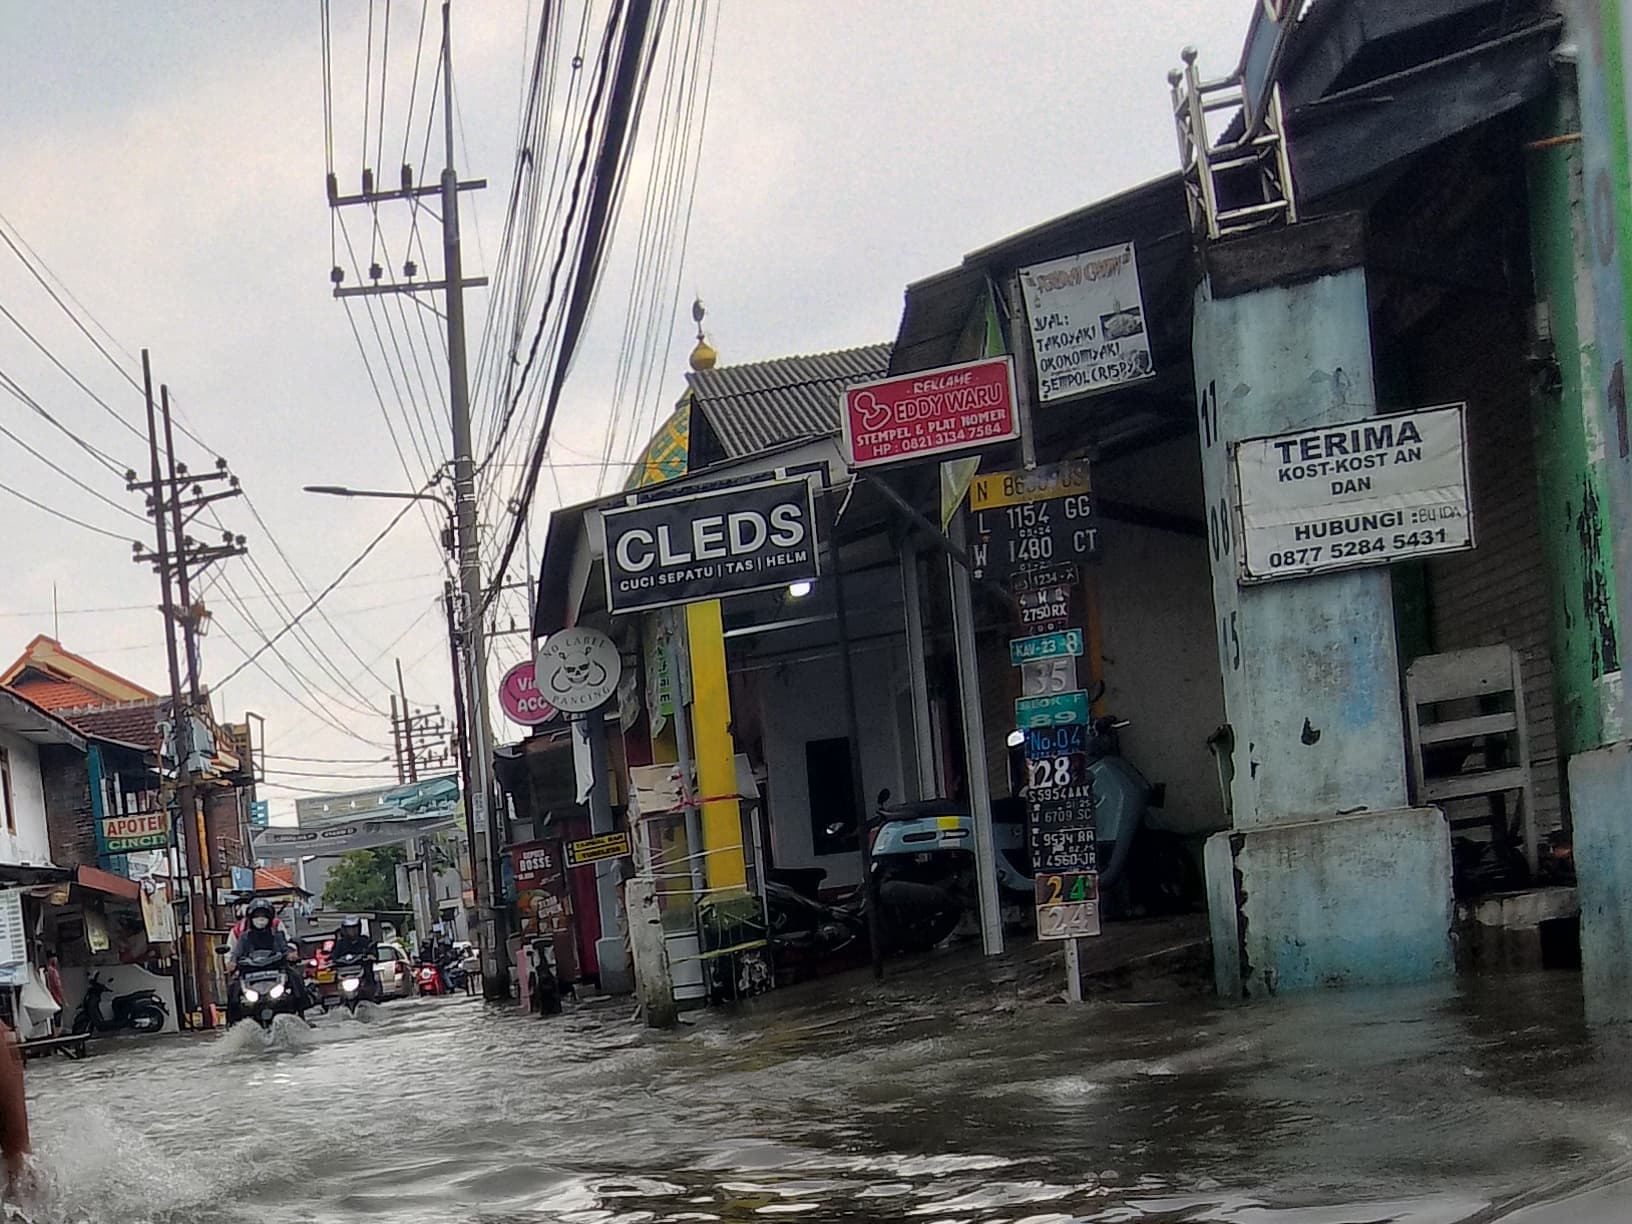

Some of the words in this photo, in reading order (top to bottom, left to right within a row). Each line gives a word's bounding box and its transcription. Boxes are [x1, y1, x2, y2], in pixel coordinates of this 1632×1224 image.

[1036, 325, 1096, 352] TAKOYAKI
[913, 372, 973, 394] REKLAME
[894, 394, 944, 423] EDDY
[944, 383, 1002, 413] WARU
[856, 427, 911, 447] STEMPEL
[928, 417, 956, 433] PLAT
[961, 409, 1006, 427] NOMER
[872, 444, 892, 457] HP
[902, 435, 932, 451] 0821
[935, 430, 965, 446] 3134
[969, 422, 1002, 438] 7584
[1274, 420, 1423, 465] TERIMA
[1278, 453, 1388, 483] KOST-KOST
[1393, 447, 1422, 464] AN
[976, 480, 988, 502] N
[1331, 477, 1372, 496] DAN
[979, 512, 991, 534] L
[1006, 502, 1050, 529] 1154
[1065, 495, 1090, 519] GG
[1294, 511, 1403, 541] HUBUNGI
[616, 503, 805, 572] CLEDS
[973, 543, 987, 566] W
[1009, 536, 1053, 562] 1480
[1073, 528, 1097, 552] CT
[1269, 547, 1322, 568] 0877
[1331, 538, 1385, 559] 5284
[1393, 528, 1447, 550] 5431
[620, 577, 655, 591] CUCI
[658, 567, 713, 585] SEPATU
[725, 560, 754, 574] TAS
[766, 551, 807, 567] HELM
